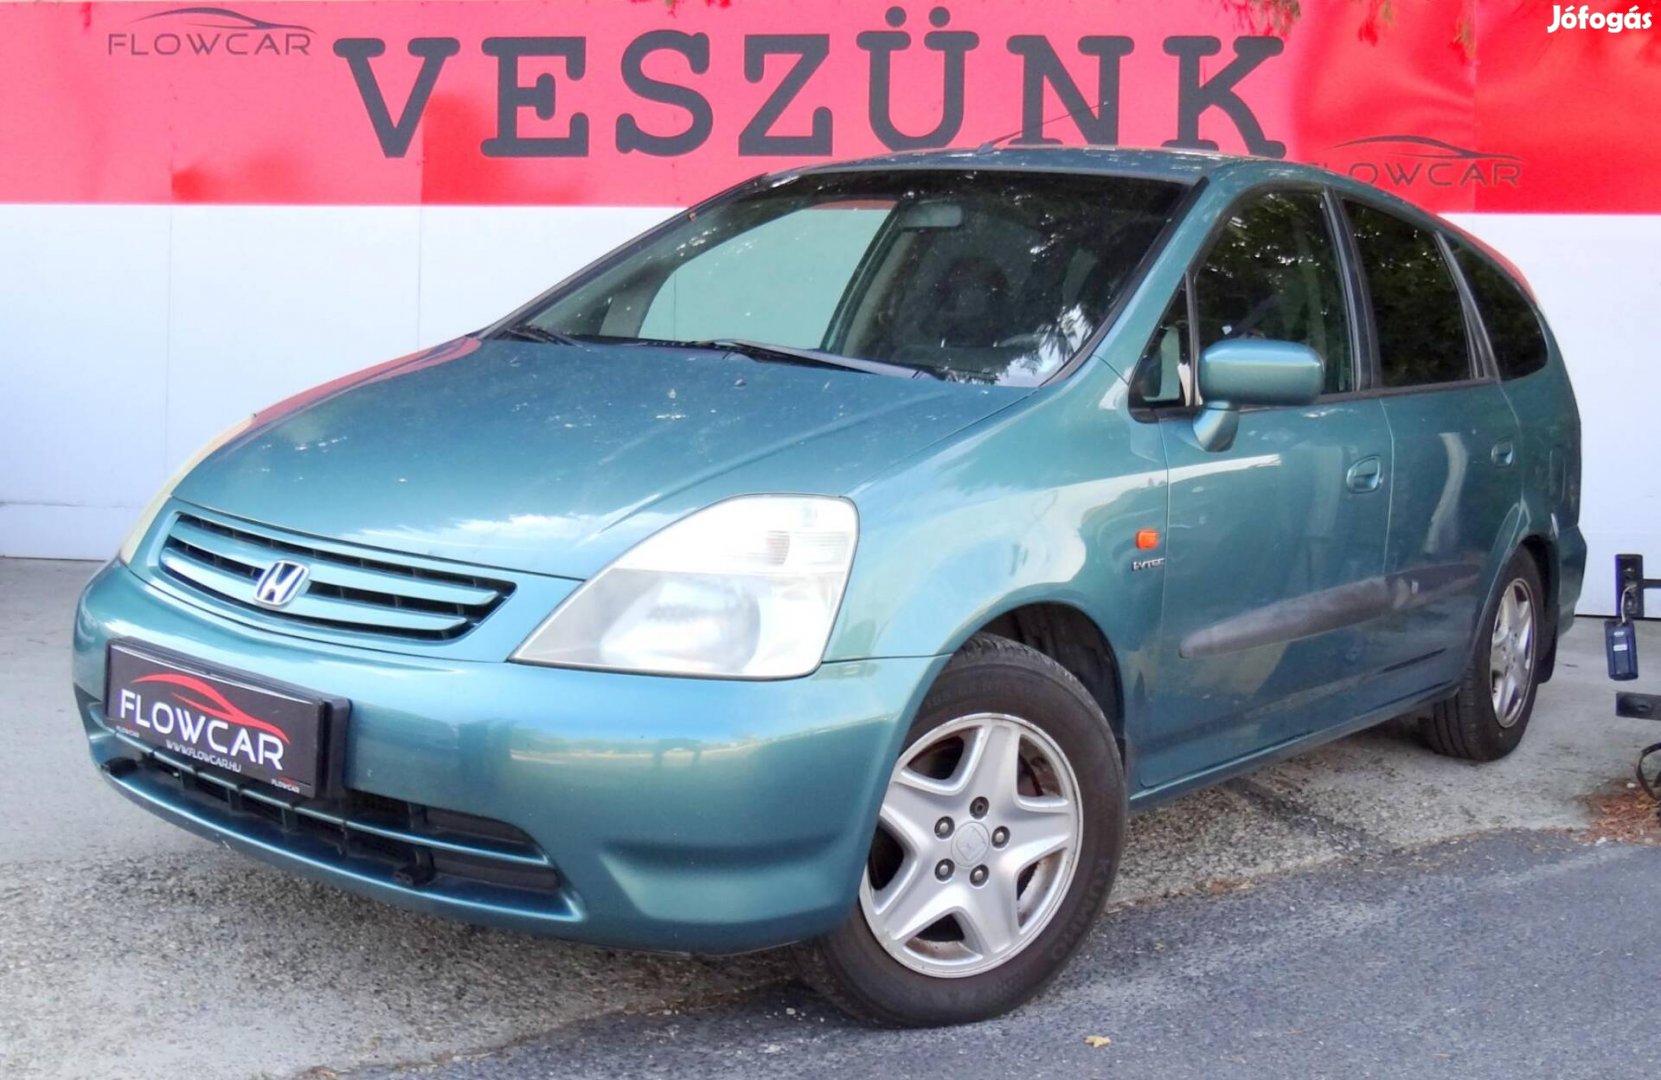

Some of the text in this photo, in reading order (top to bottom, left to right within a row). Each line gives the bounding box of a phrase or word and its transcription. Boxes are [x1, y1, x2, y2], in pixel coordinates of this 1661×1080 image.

[108, 33, 311, 56] FLOWCAR
[333, 6, 1287, 159] VESZÜNK
[1306, 162, 1521, 187] OWCAR
[120, 689, 284, 771] FLOWCAR
